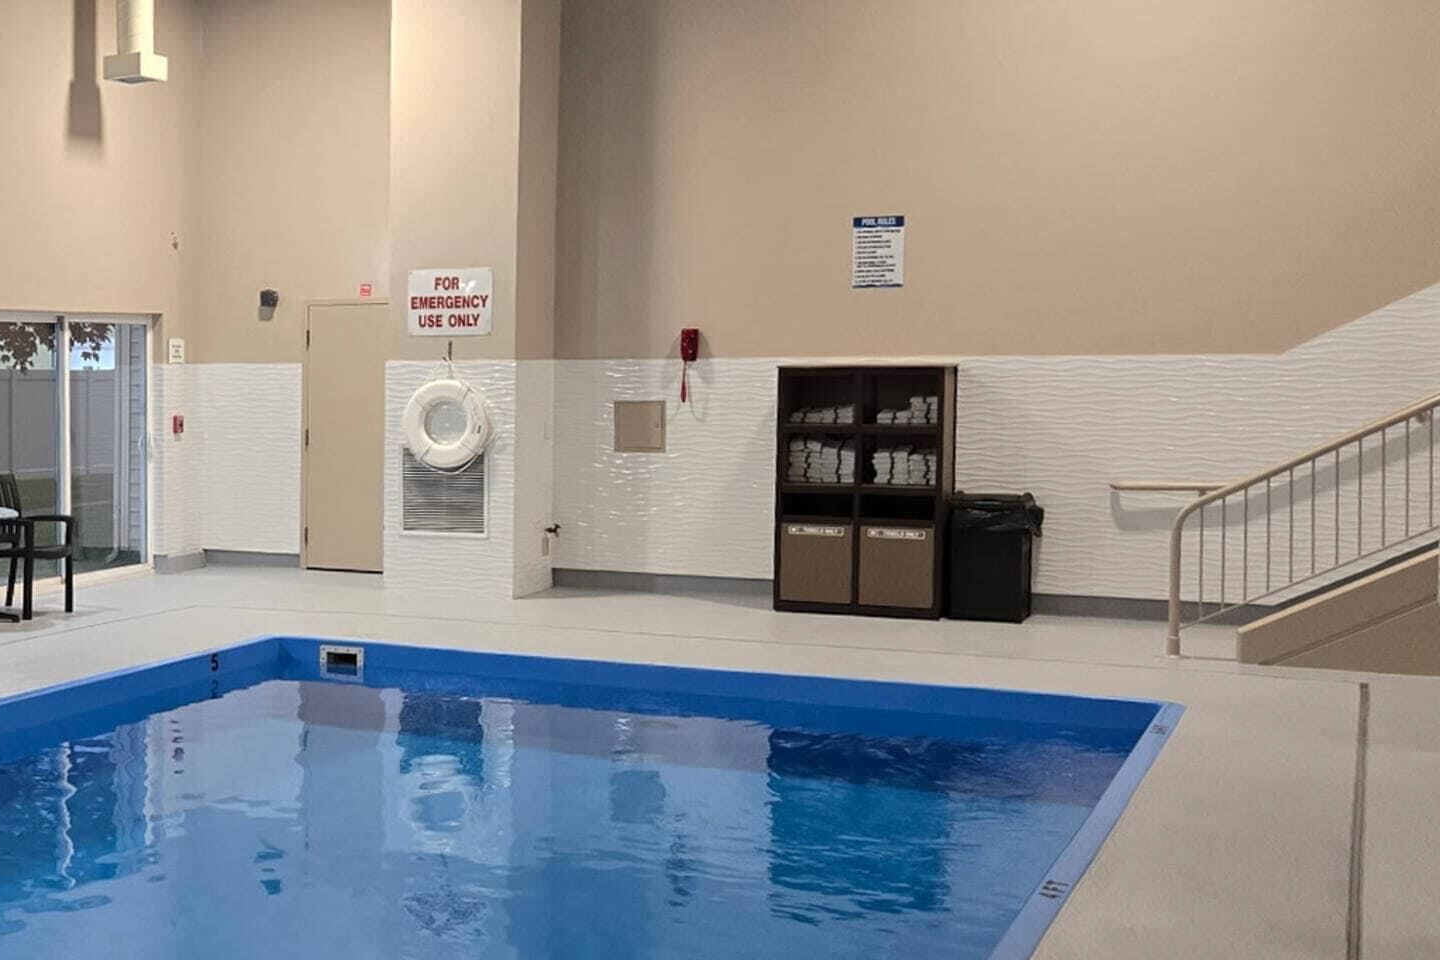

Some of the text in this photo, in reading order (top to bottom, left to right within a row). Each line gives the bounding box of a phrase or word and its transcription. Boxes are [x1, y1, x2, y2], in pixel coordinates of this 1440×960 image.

[861, 217, 897, 226] POOL RULES
[434, 276, 460, 291] FOR
[410, 294, 489, 310] EMERGENCY
[418, 313, 480, 328] USE ONLY
[210, 652, 219, 672] 5
